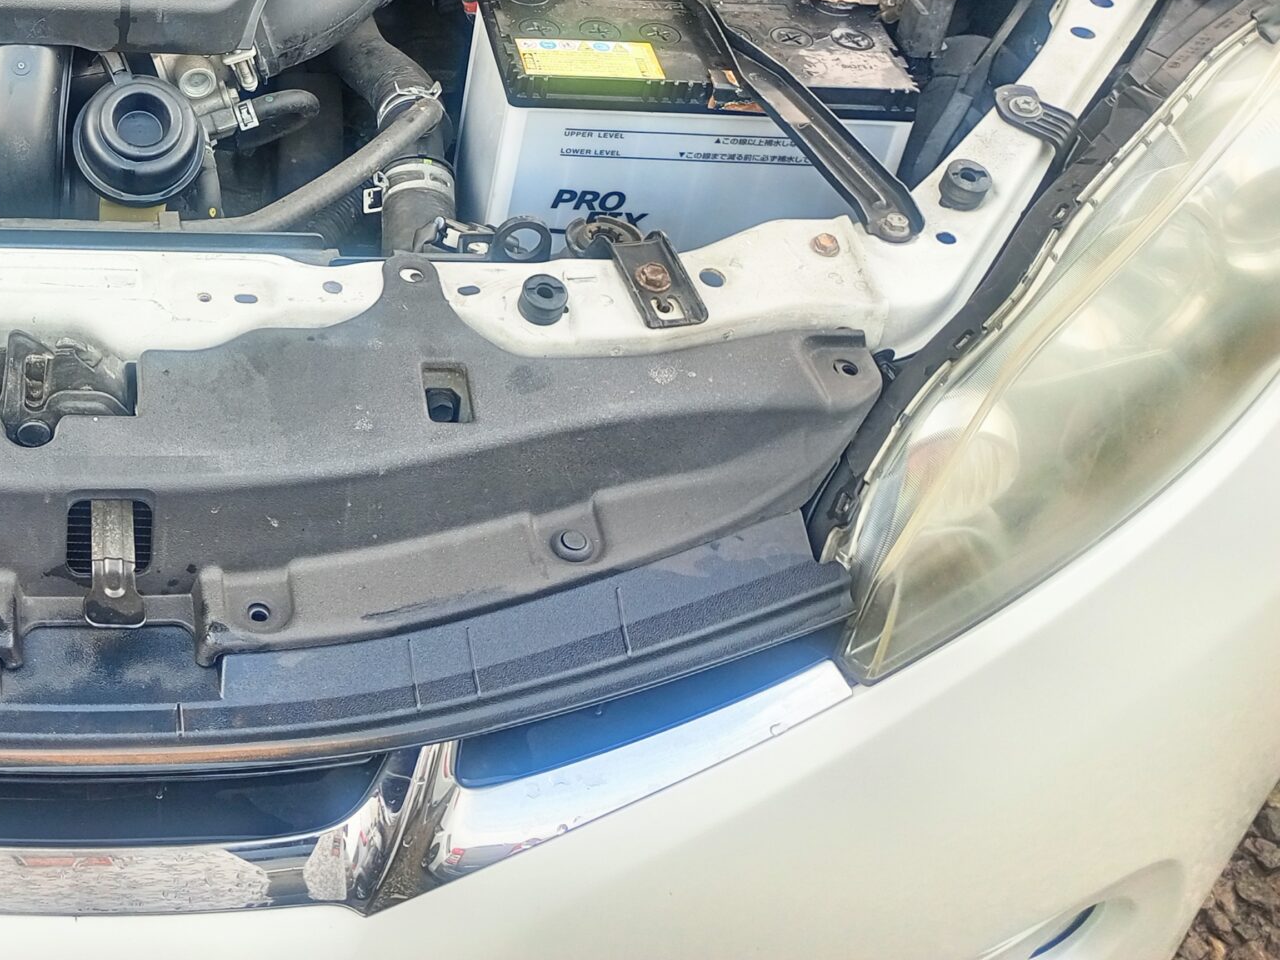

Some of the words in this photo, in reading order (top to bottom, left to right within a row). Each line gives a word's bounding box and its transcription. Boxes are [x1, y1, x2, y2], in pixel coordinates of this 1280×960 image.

[563, 130, 594, 138] UPPER
[560, 147, 592, 155] LOWER
[550, 188, 627, 212] PRO
